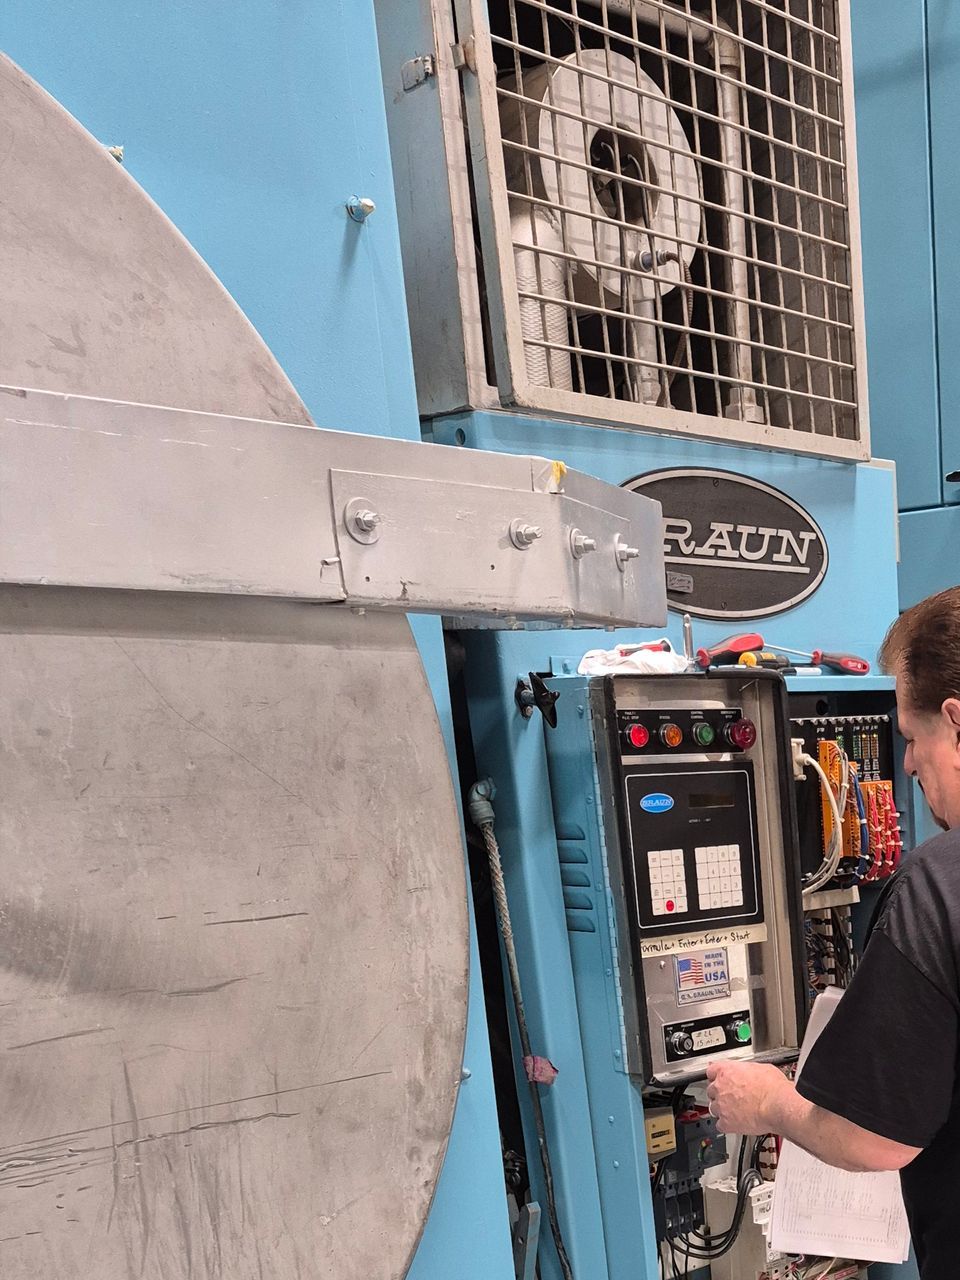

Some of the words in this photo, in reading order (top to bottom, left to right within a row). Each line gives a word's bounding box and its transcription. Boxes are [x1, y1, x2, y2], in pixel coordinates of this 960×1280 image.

[663, 517, 816, 564] RAUN
[678, 939, 697, 949] Enter
[704, 933, 723, 945] Enter
[730, 931, 751, 942] Start
[704, 971, 727, 982] USA
